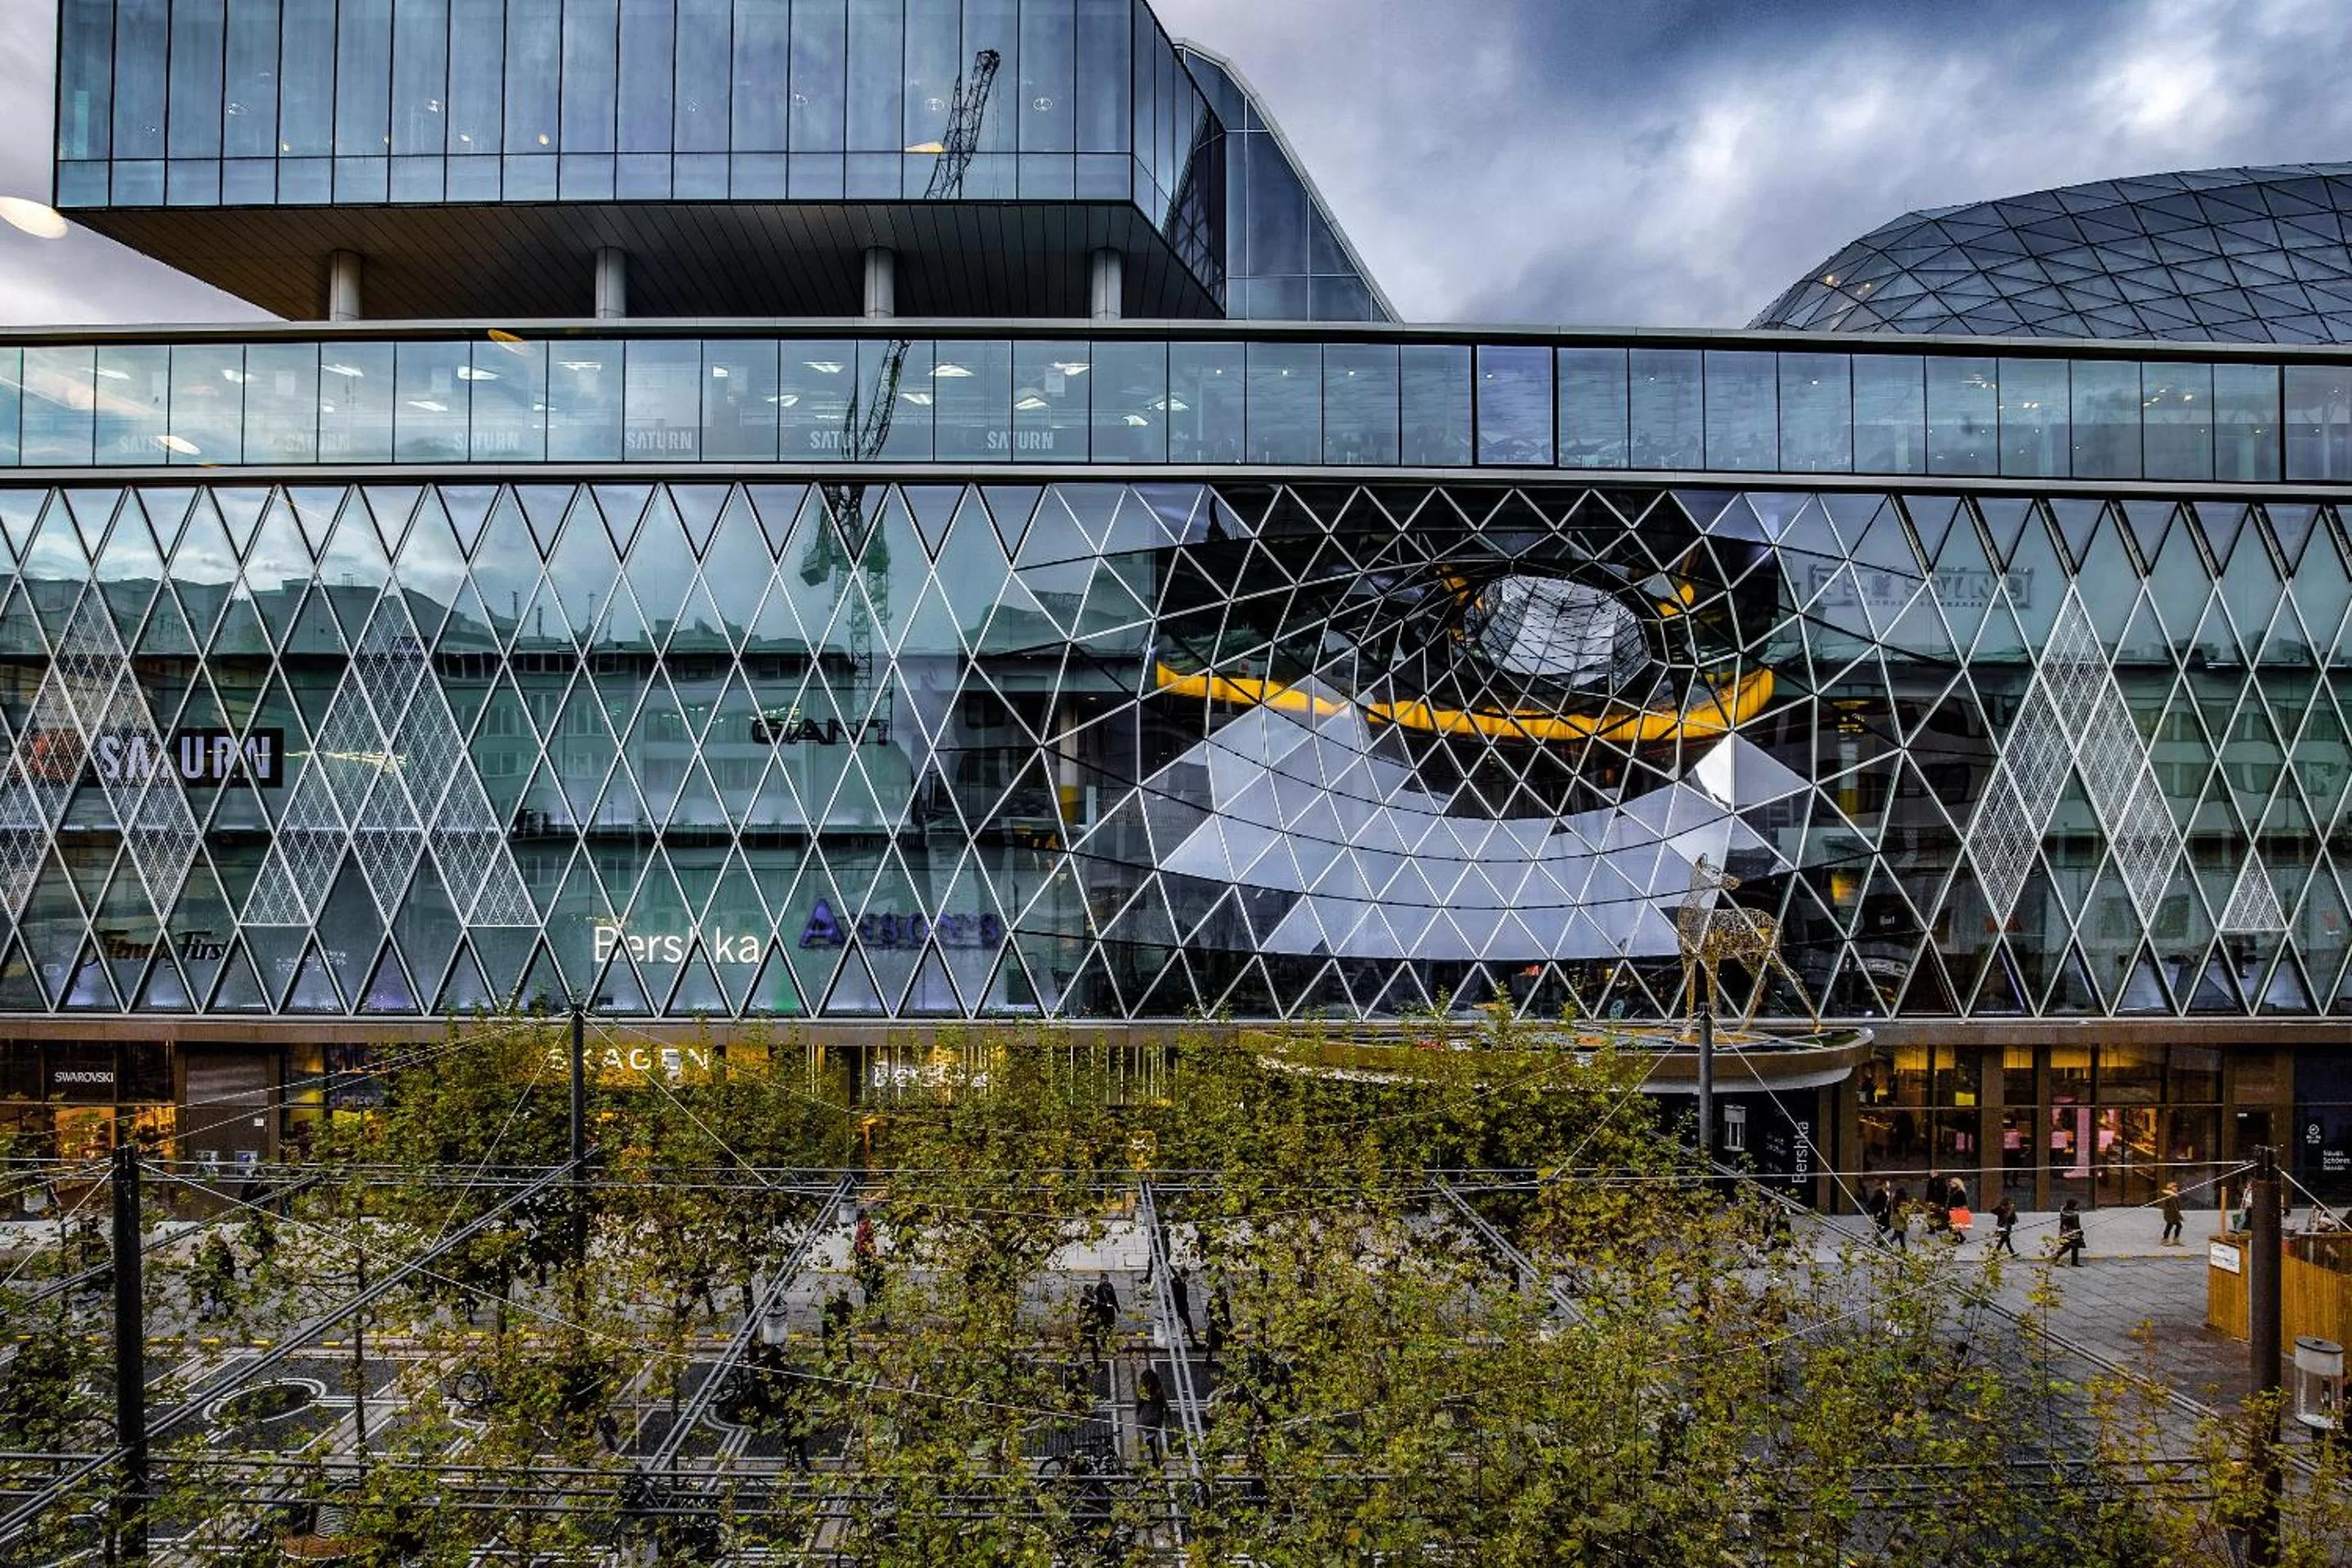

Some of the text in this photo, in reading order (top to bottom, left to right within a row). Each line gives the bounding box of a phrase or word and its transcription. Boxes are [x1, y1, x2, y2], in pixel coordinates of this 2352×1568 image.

[626, 431, 693, 449] SATURN
[987, 430, 1054, 449] SATURN
[751, 718, 889, 745] GANT
[99, 736, 271, 778] SAURN
[54, 1071, 114, 1083] SWAROVSKI
[1792, 1121, 1809, 1183] Bershka
